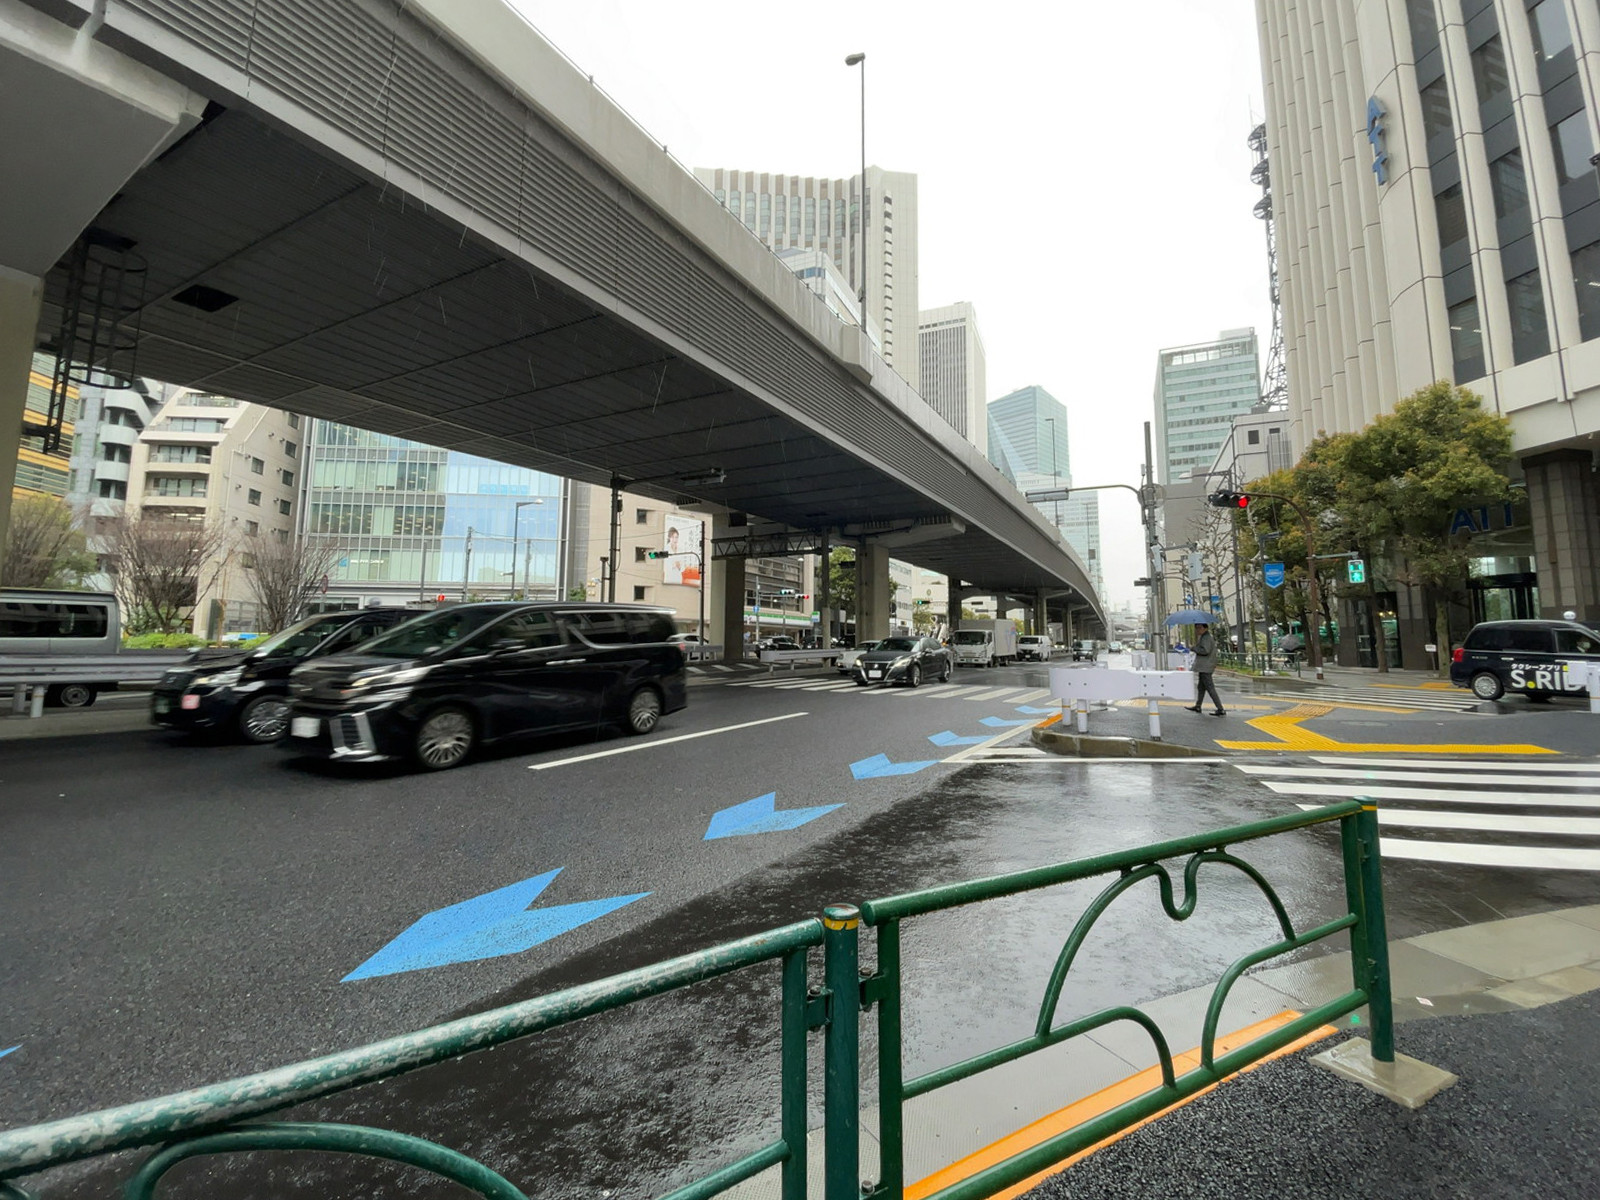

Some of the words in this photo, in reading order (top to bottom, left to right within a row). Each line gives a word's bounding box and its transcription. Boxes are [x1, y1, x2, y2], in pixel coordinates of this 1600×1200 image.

[1511, 663, 1560, 671] タクシーアプリ
